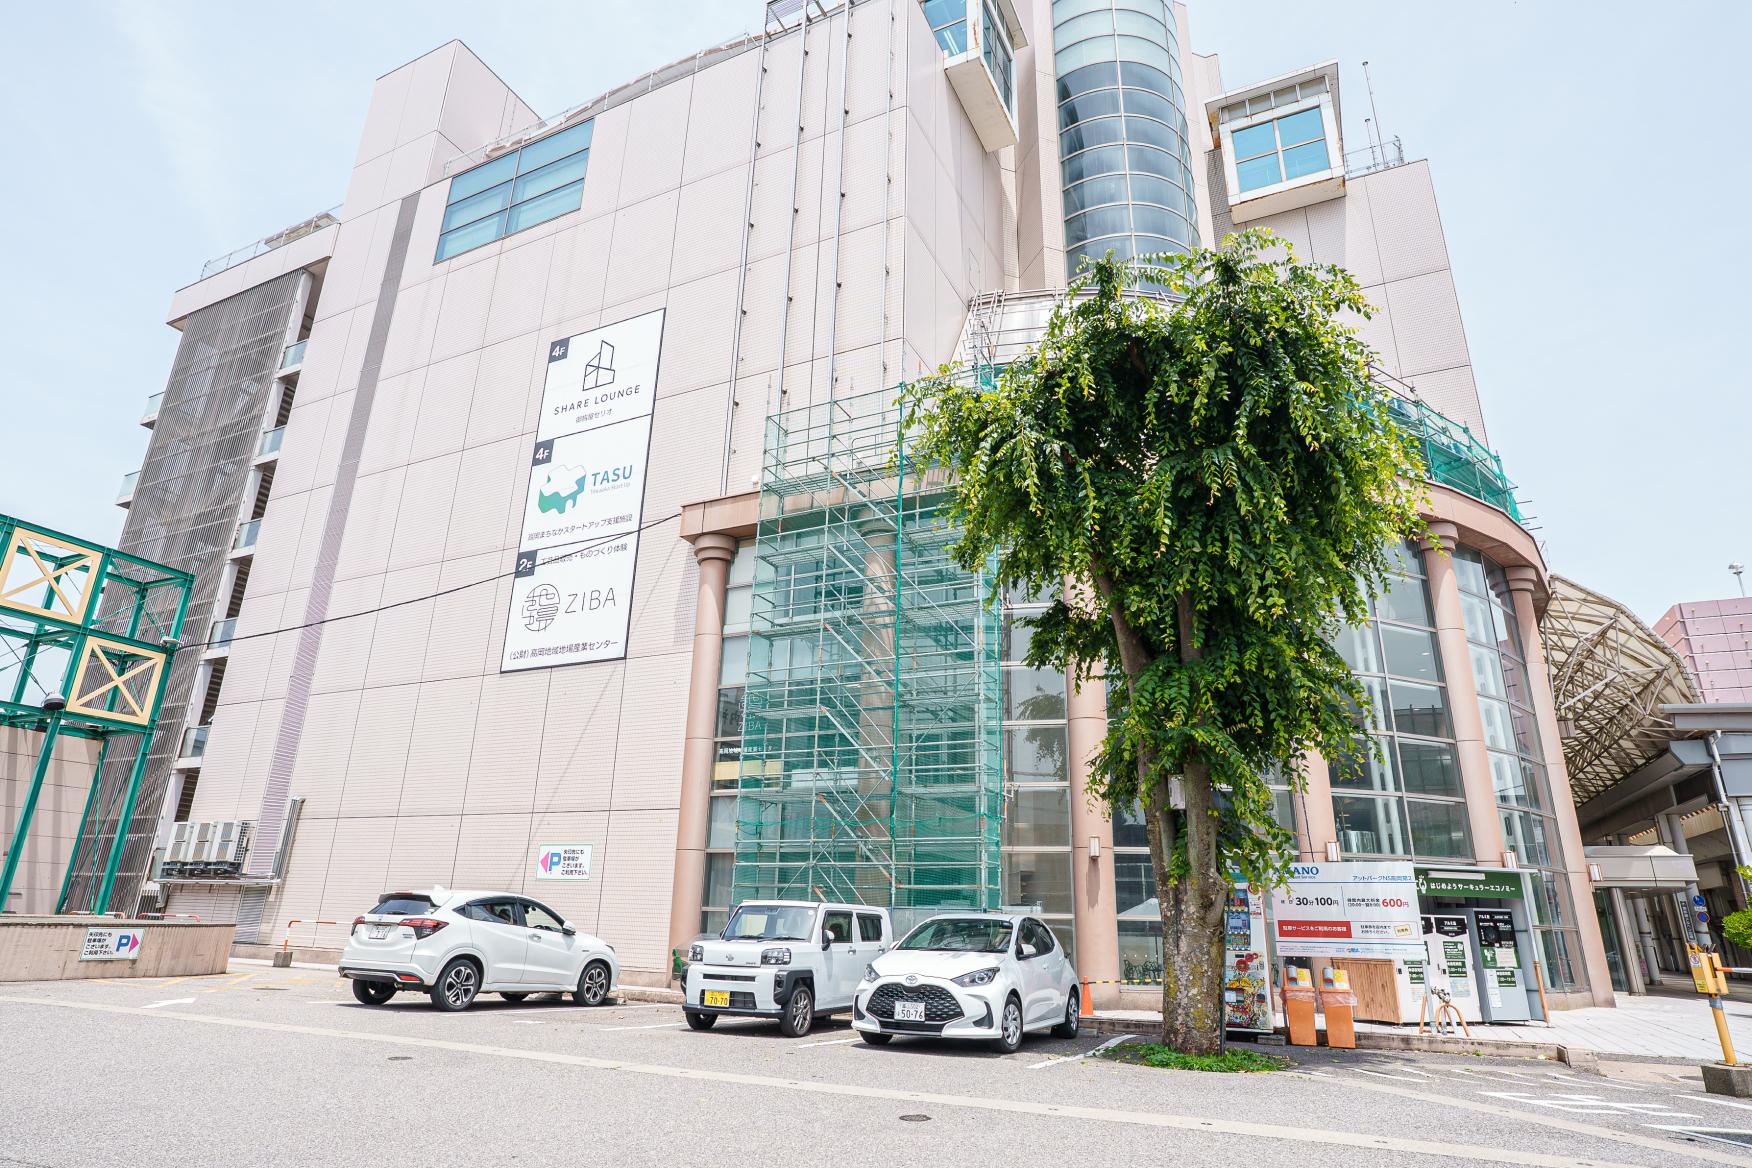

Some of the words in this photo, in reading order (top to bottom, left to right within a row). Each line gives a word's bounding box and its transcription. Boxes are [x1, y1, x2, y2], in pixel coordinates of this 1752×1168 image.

[552, 345, 566, 357] 4F
[553, 398, 590, 416] SHARE
[594, 384, 641, 405] LOUNGE
[535, 447, 550, 460] 4F
[591, 464, 633, 486] TASU
[518, 559, 533, 572] 2F
[564, 587, 616, 614] ZIBA
[737, 720, 762, 732] ZBA
[1430, 882, 1516, 892] はじめようサーキュラーエコノミー
[1382, 898, 1409, 907] 600円
[710, 996, 728, 1006] 70-70
[901, 1009, 924, 1019] 50-76
